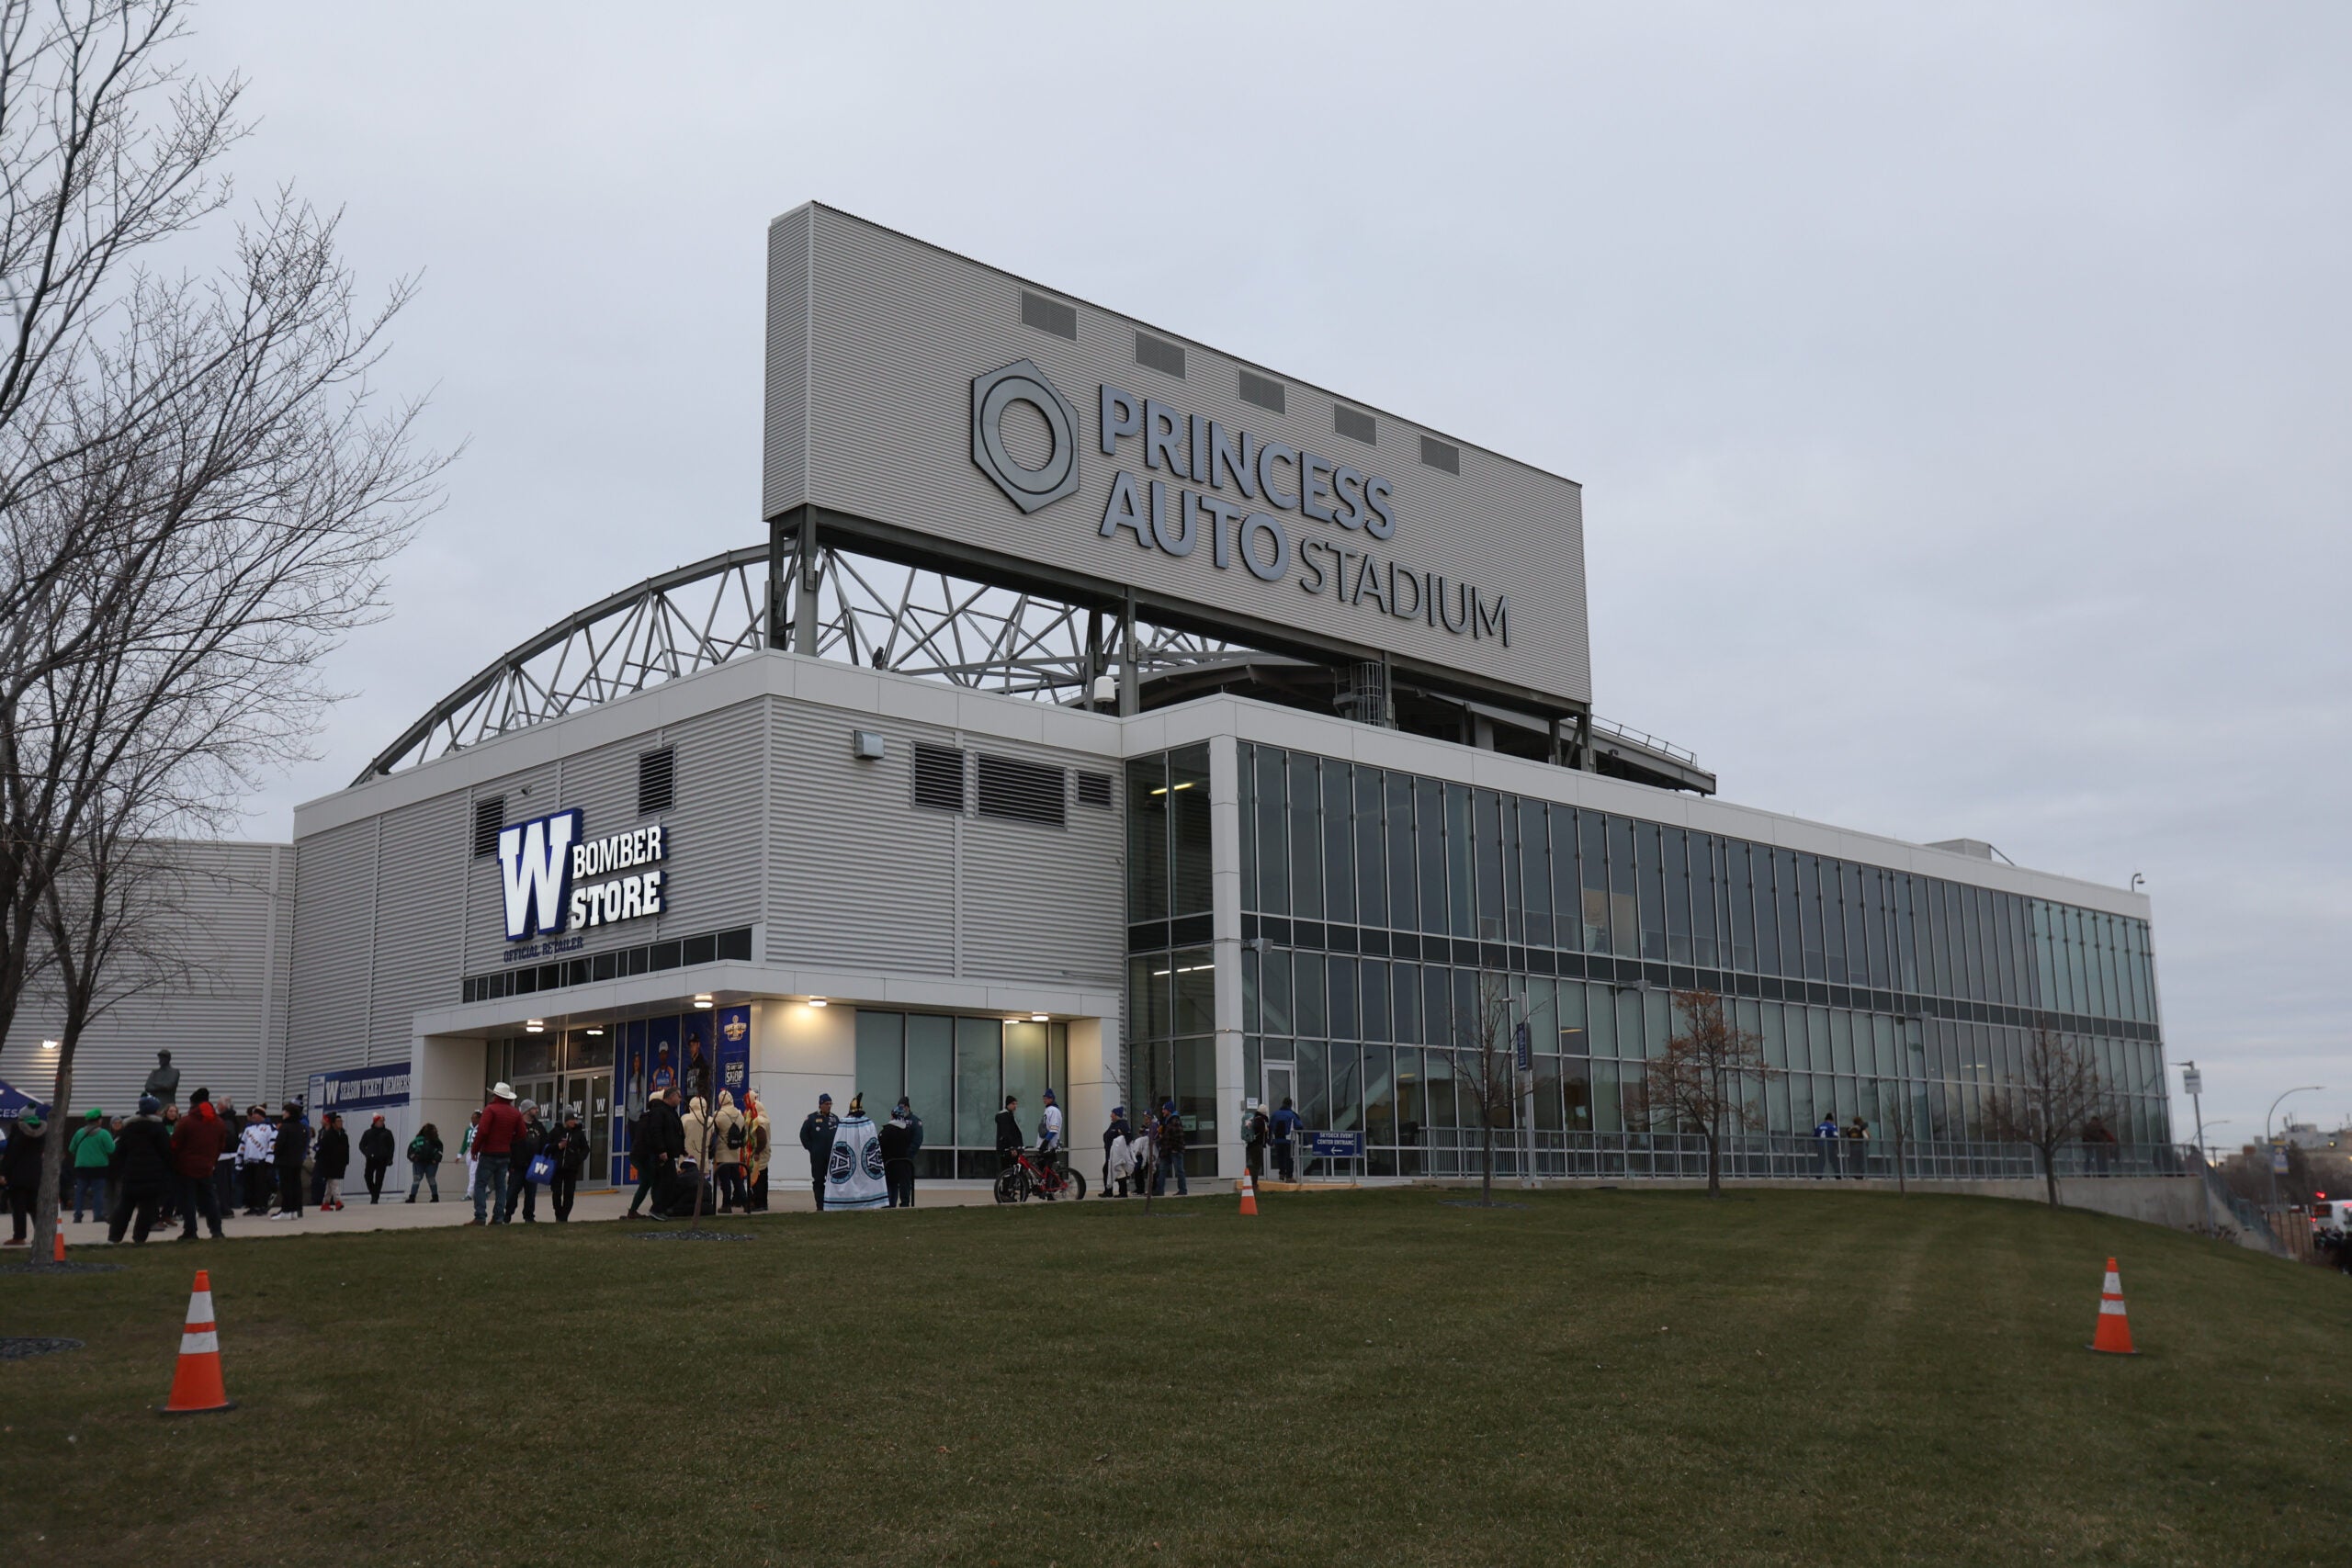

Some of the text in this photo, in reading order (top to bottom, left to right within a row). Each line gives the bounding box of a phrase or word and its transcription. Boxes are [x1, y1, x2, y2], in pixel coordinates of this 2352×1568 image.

[1100, 383, 1396, 540] PRINCESS
[1098, 470, 1511, 648] AUTO STADIUM
[572, 825, 662, 880] BOMBER
[497, 811, 574, 939] W
[571, 870, 662, 930] STORE
[503, 936, 583, 963] OFFICIAL RETAILER
[325, 1080, 339, 1105] W
[340, 1079, 360, 1101] SEASON
[361, 1077, 382, 1099] TICKET
[596, 1098, 605, 1112] W
[540, 1103, 549, 1117] W
[573, 1100, 582, 1114] W
[534, 1162, 548, 1175] W
